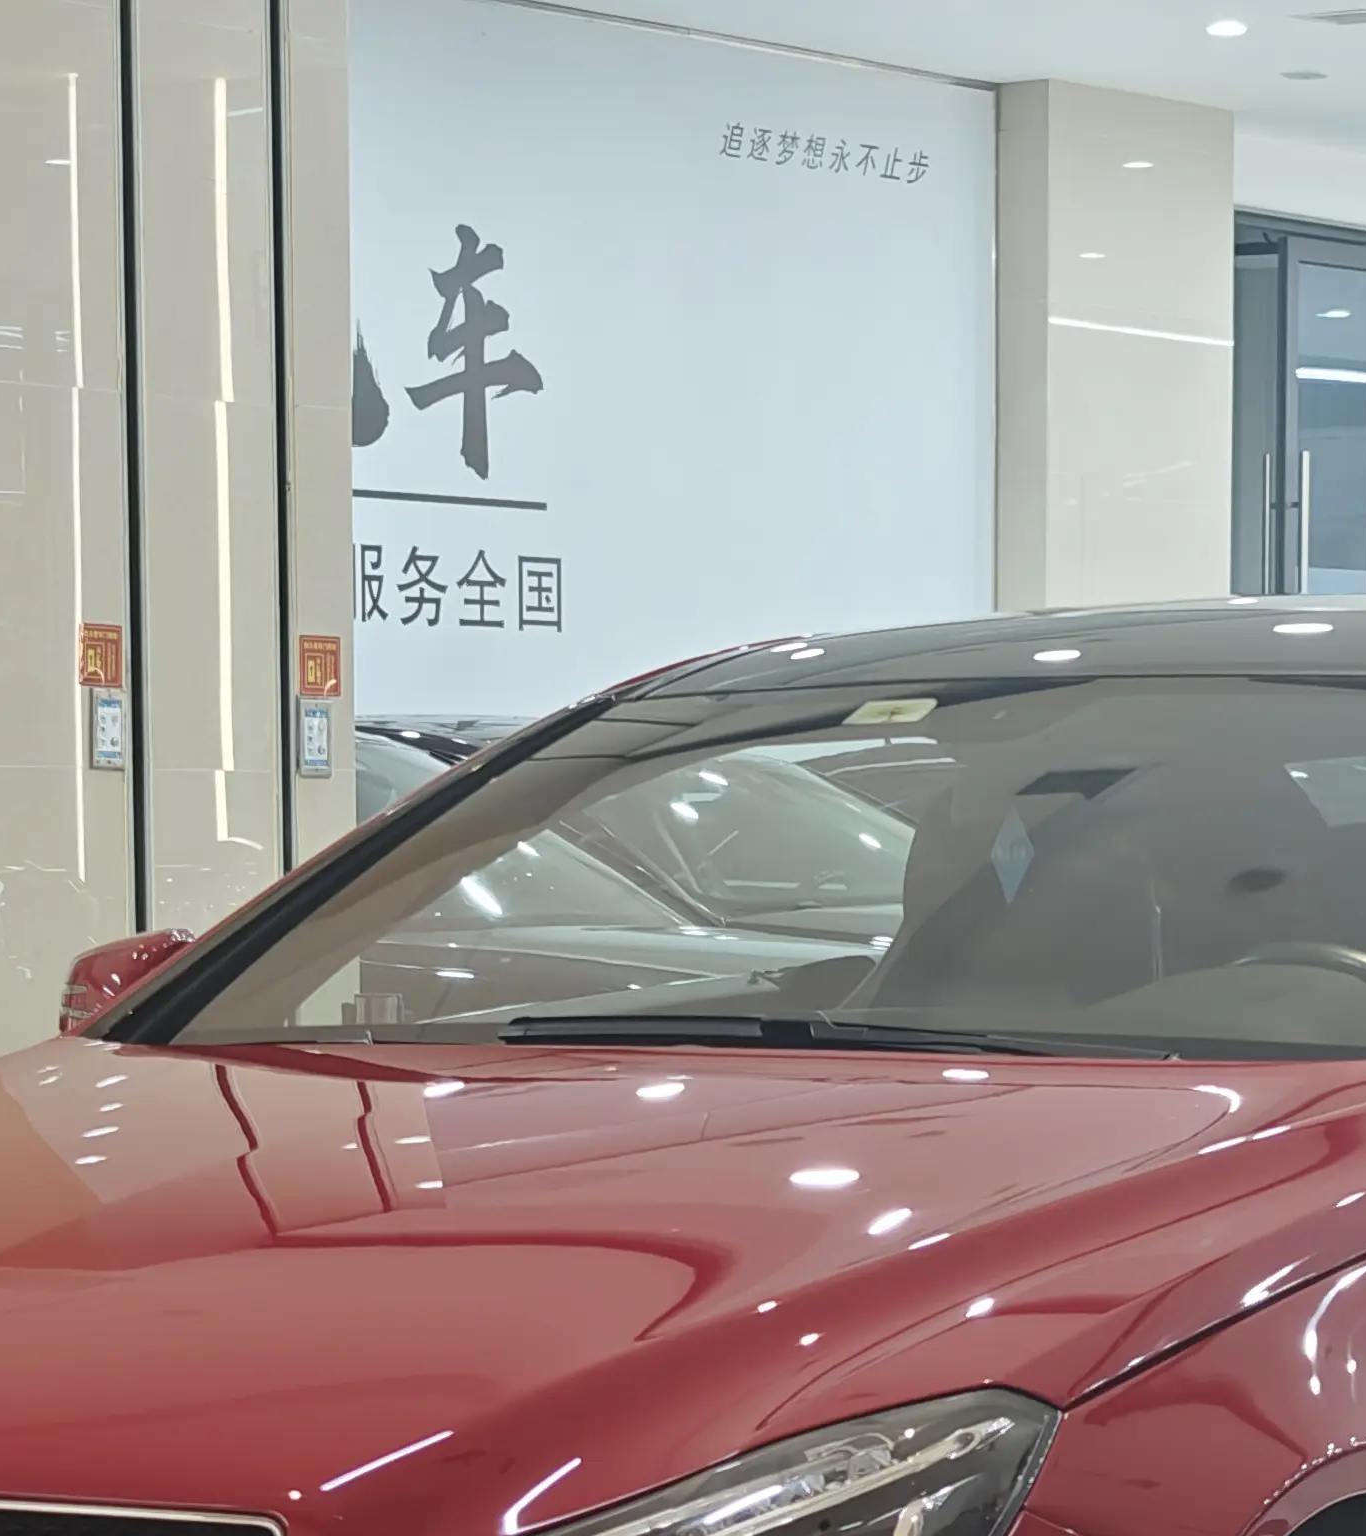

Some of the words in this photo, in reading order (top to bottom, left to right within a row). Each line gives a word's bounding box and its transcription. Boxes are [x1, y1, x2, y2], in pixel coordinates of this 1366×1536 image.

[718, 121, 930, 185] 追逐梦想永不止步
[352, 543, 563, 633] 服务全国
